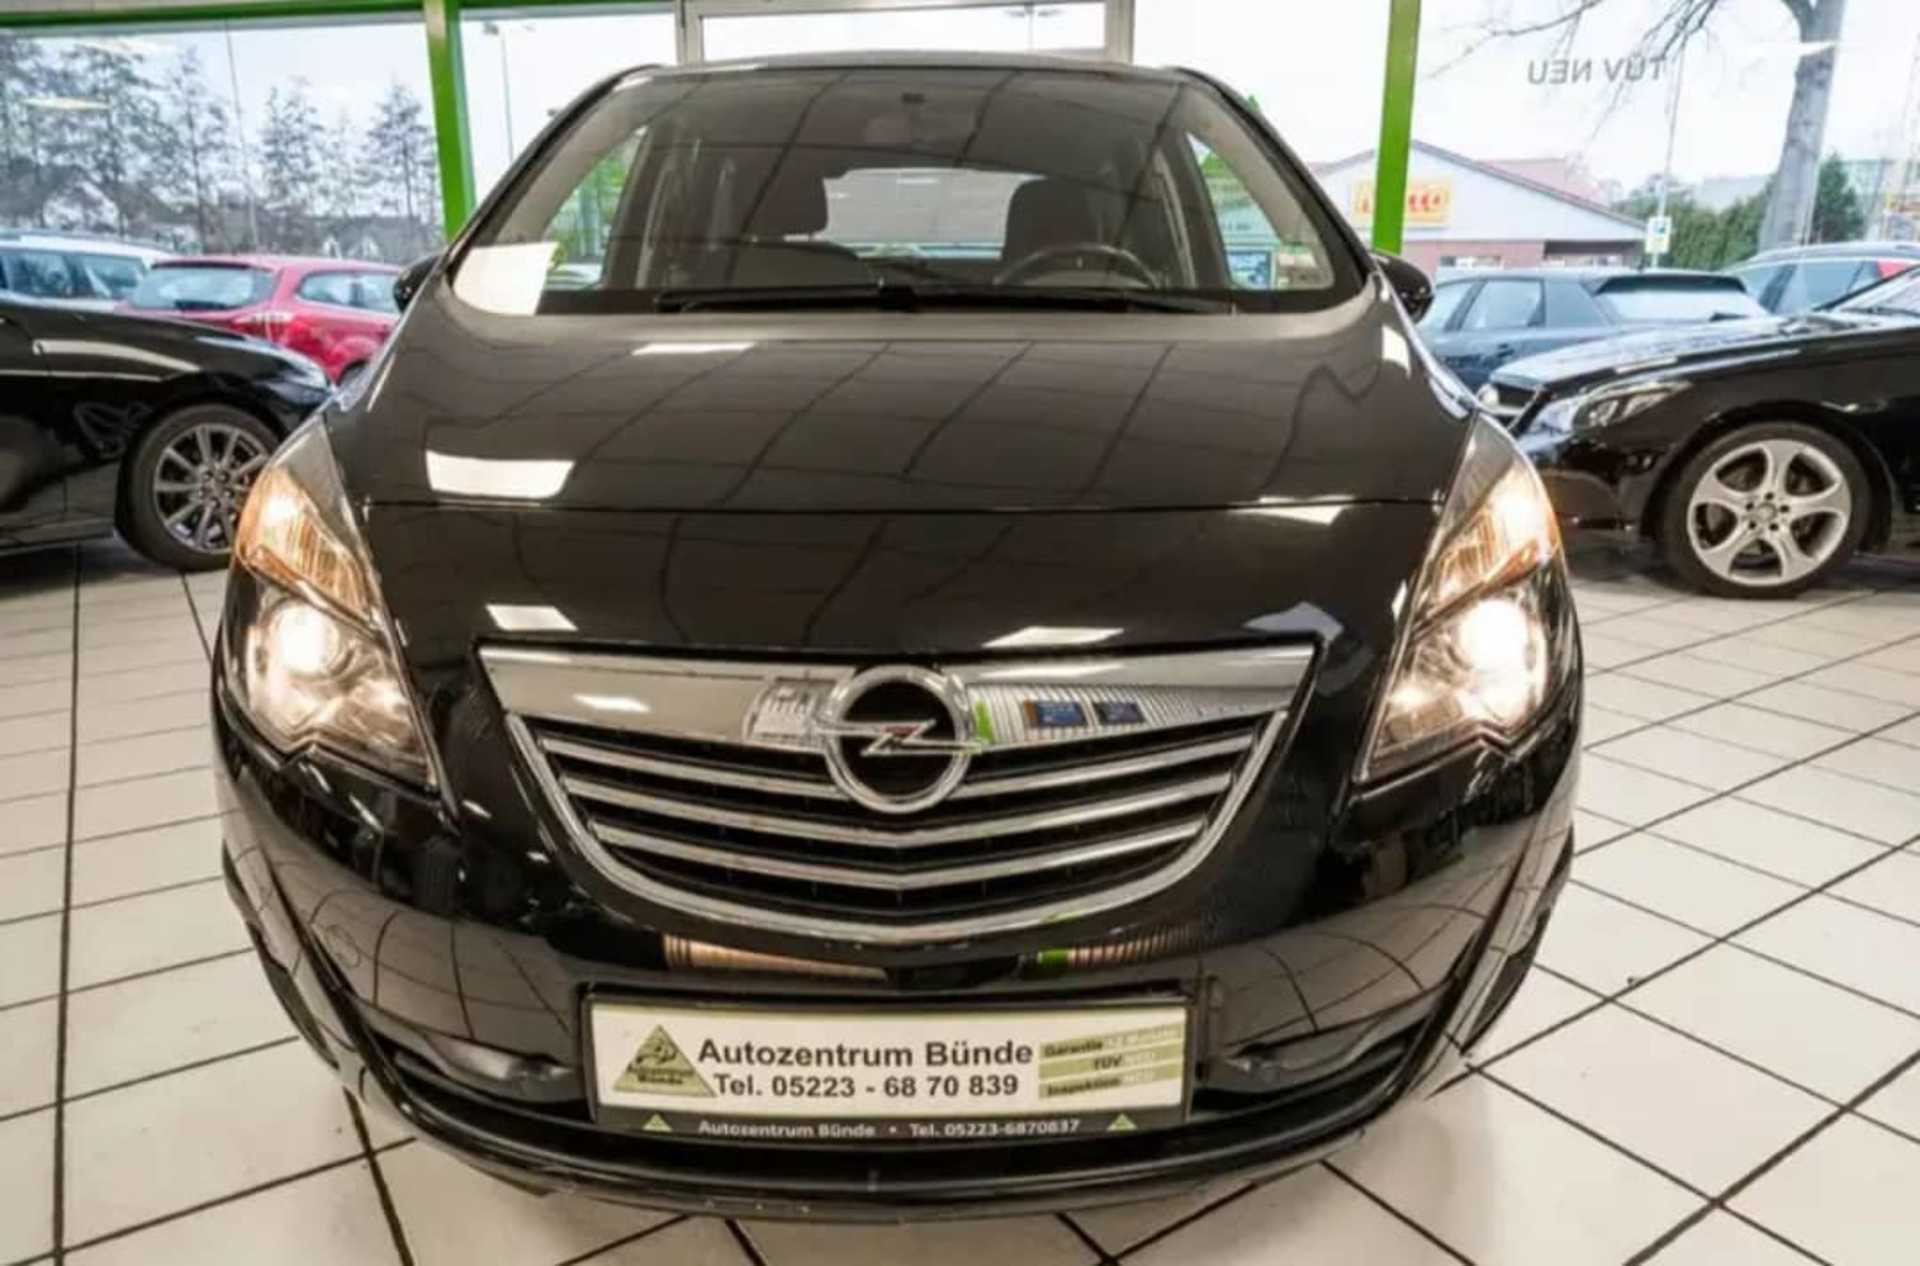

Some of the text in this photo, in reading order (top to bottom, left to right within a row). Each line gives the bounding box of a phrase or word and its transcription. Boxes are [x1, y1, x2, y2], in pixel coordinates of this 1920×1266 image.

[698, 1039, 1033, 1067] Autozentrum Bünde
[713, 1072, 763, 1096] Tel.
[772, 1075, 855, 1098] 05223
[884, 1076, 917, 1098] 68
[926, 1075, 959, 1097] 70
[969, 1073, 1018, 1096] 839
[699, 1120, 815, 1138] Autozentrum
[818, 1123, 876, 1138] Bünde
[909, 1123, 940, 1137] Tel.
